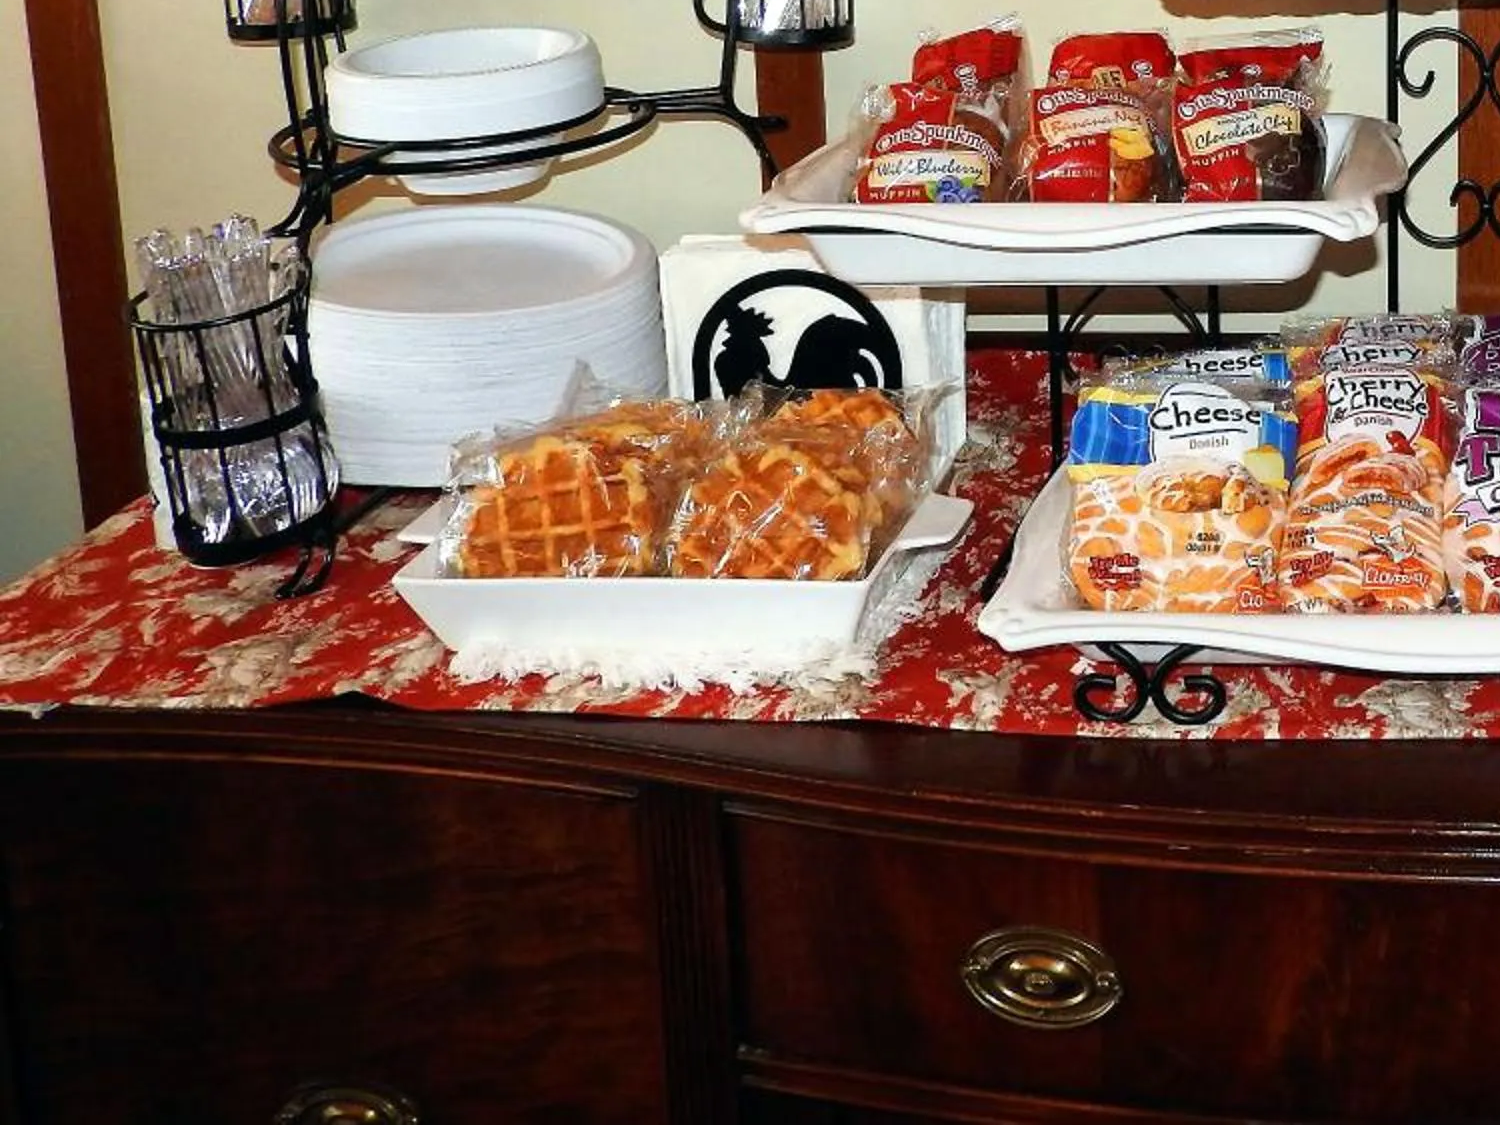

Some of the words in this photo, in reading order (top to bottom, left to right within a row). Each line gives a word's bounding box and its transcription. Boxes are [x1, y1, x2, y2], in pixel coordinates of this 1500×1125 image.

[1195, 124, 1262, 150] Chocolate
[1263, 113, 1293, 132] Chip
[917, 158, 983, 180] Blueberry
[869, 190, 921, 200] MUFFIN
[1184, 352, 1264, 374] heese
[1328, 377, 1426, 406] Cherry
[1351, 390, 1428, 416] Cheese
[1150, 401, 1262, 431] Cheese
[1354, 416, 1394, 427] Danish
[1188, 435, 1229, 450] Danish
